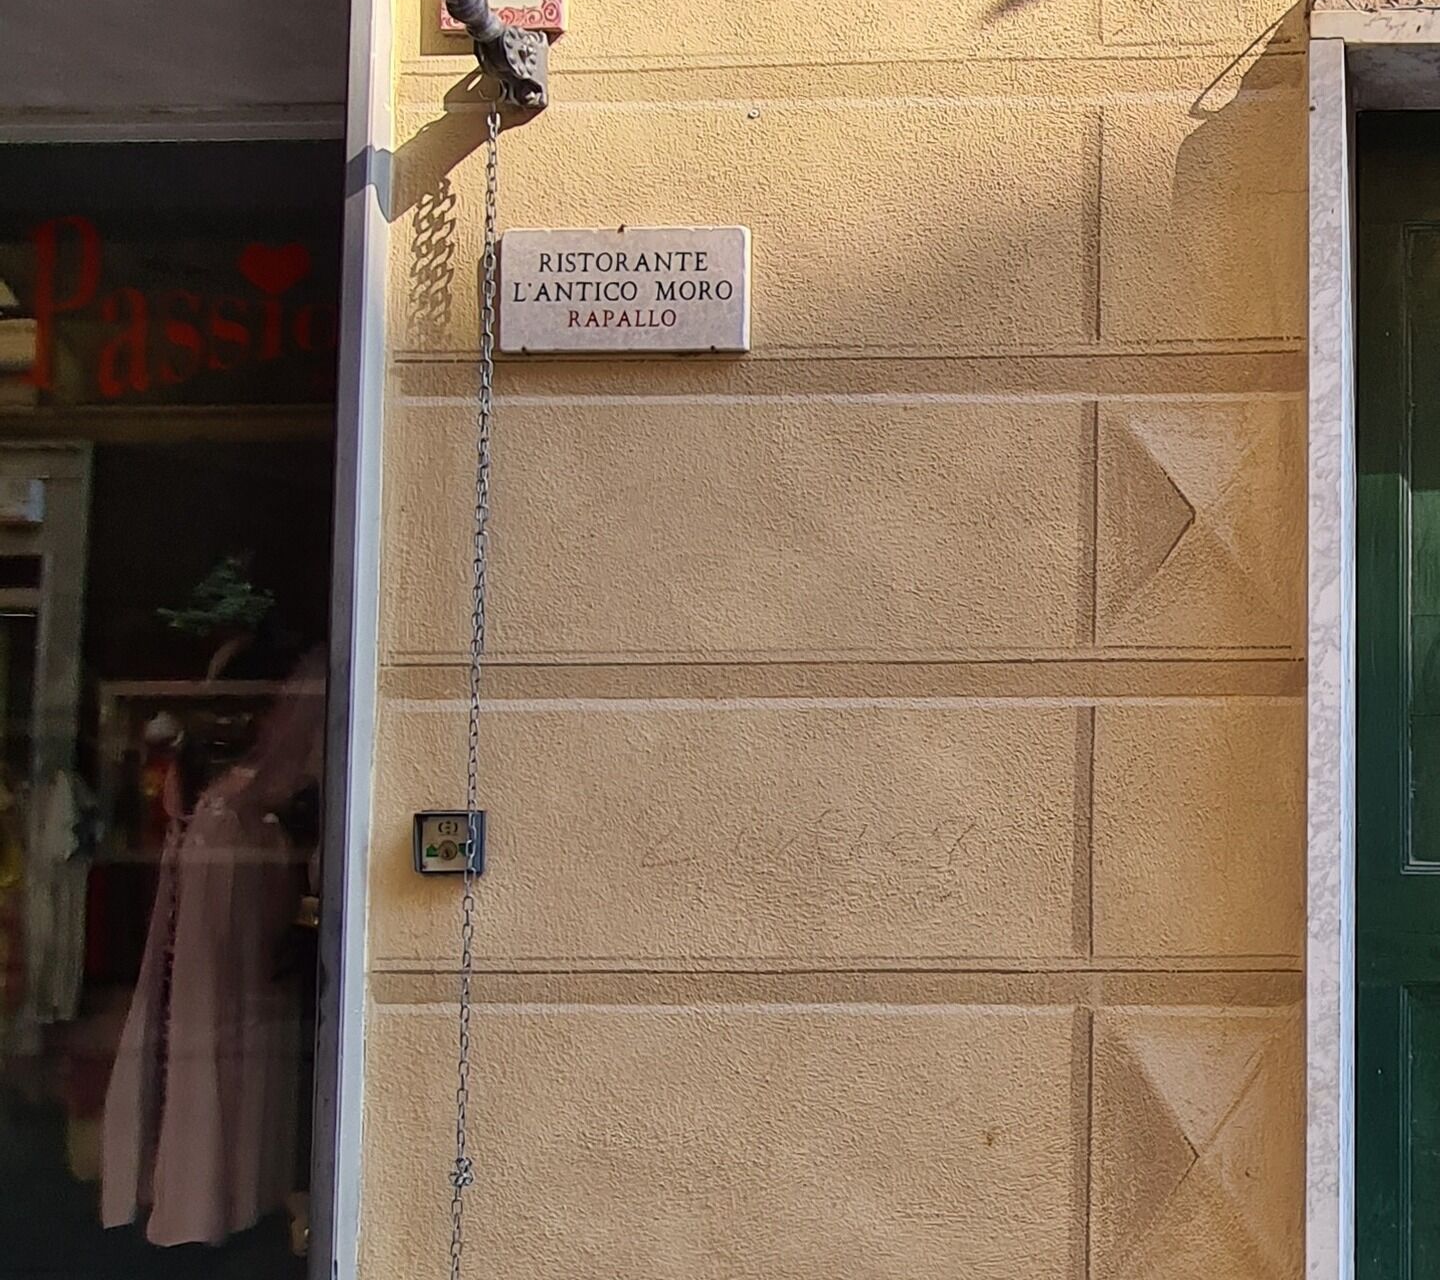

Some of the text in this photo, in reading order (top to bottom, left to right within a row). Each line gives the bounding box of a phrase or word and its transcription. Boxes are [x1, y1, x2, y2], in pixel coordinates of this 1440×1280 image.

[538, 251, 709, 273] RISTORANTE
[512, 280, 734, 303] L'ANTICO MORO
[567, 308, 678, 328] RAPALLO
